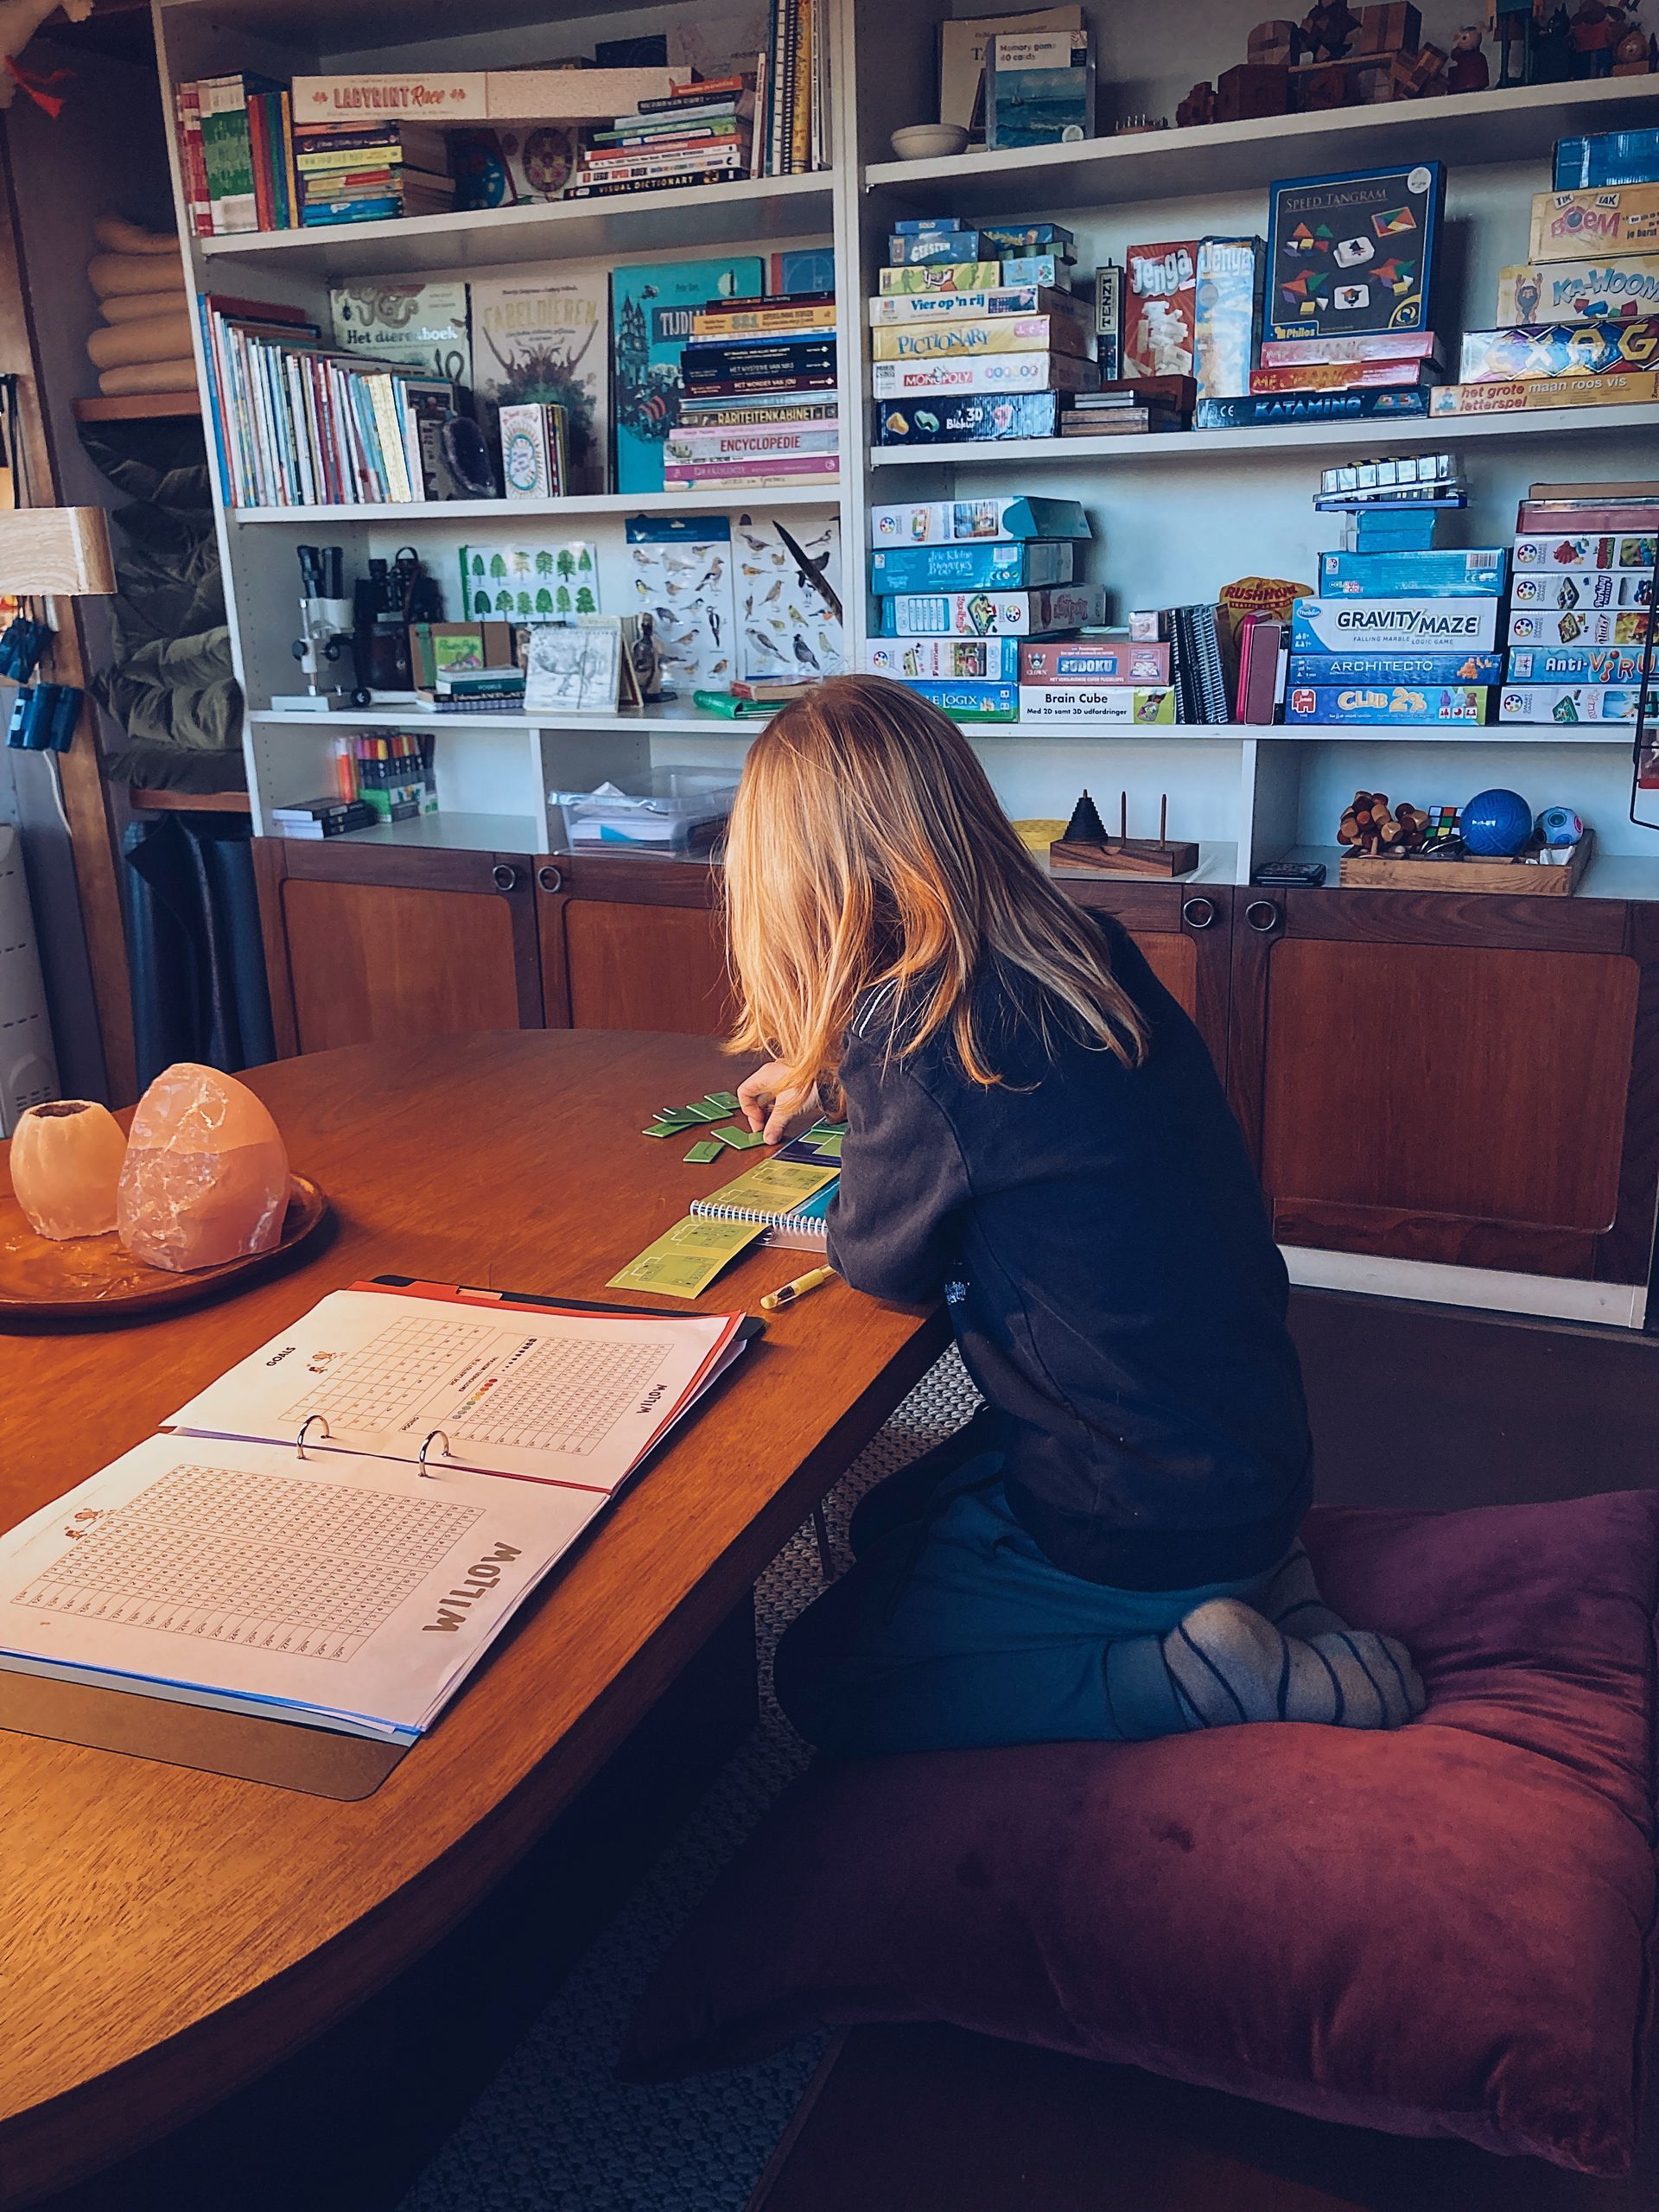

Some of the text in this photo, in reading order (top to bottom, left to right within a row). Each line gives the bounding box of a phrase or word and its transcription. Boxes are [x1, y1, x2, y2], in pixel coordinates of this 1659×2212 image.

[1000, 44, 1031, 53] Memory
[334, 85, 446, 108] LABYRINT Race
[599, 175, 695, 194] VISUAL DICTIONARY
[1286, 189, 1388, 209] SPEED TANGRAM
[1555, 194, 1572, 206] TIK
[1200, 241, 1253, 276] Jenga
[1130, 249, 1194, 296] Jenga
[911, 294, 985, 310] Vier op 'n rij
[1102, 278, 1112, 327] TENZI
[484, 298, 596, 333] FABELDIEREN
[347, 329, 372, 344] Het
[897, 328, 990, 354] PICTIONARY
[1287, 327, 1315, 338] Philos
[906, 372, 971, 386] MONOPOLY
[1529, 376, 1628, 393] maan roos vis
[1461, 384, 1525, 400] het grote
[1254, 397, 1362, 417] KATAMINO
[1459, 396, 1528, 412] letterspel
[717, 408, 815, 425] RARITEITENKABINET
[966, 408, 983, 421] 3D
[720, 435, 802, 453] ENCYCLOPEDIE
[1224, 586, 1262, 601] RUSH
[1594, 576, 1610, 607] Parking
[1338, 610, 1478, 634] GRAVITY MAZE
[1060, 659, 1114, 673] SUDOKU
[1331, 661, 1433, 672] ARCHITECTO
[943, 693, 977, 706] LOGIX
[1046, 693, 1109, 703] Brain Cube
[1338, 687, 1427, 713] CLUB 2%
[1084, 708, 1128, 716] udfordringer
[266, 1346, 296, 1367] GOALS
[636, 1383, 669, 1414] WILLOW
[422, 1541, 524, 1633] WILLOW
